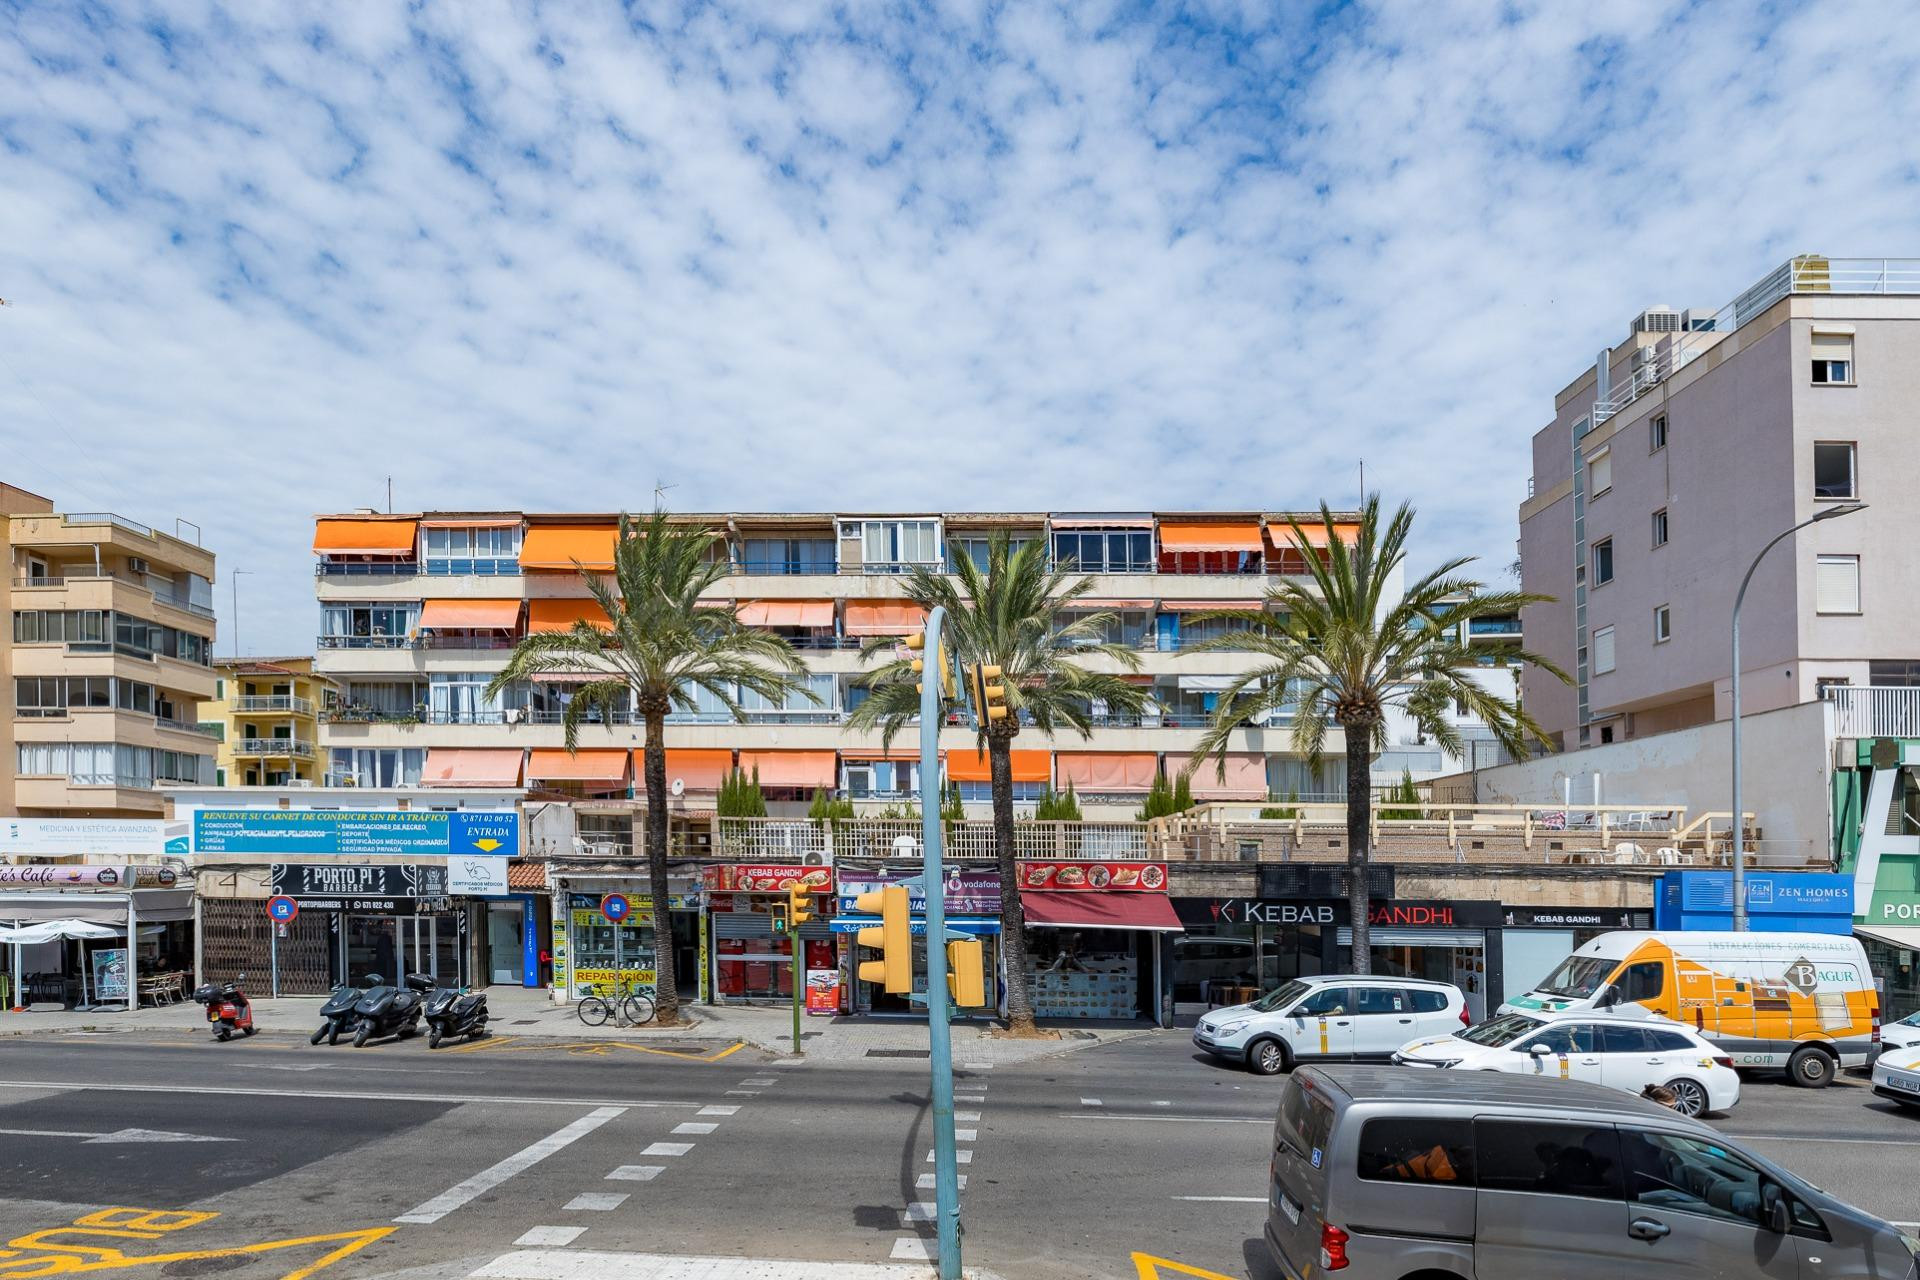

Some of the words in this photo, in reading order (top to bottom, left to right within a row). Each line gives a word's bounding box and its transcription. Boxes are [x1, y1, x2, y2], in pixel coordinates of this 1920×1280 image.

[203, 812, 248, 820] RENUEVE
[249, 812, 260, 820] SU
[263, 812, 301, 820] CARNET
[317, 813, 367, 821] CONDUCIR
[368, 813, 384, 821] SIN
[407, 812, 448, 821] TRÁFICO
[505, 815, 513, 823] 52
[40, 825, 75, 833] MEDICINA
[82, 823, 117, 833] ESTÉTICA
[118, 825, 158, 833] AVANZADA
[467, 827, 509, 836] ENTRADA
[21, 867, 56, 887] Café
[314, 868, 355, 884] PORTO
[360, 868, 372, 885] PI
[747, 868, 773, 876] KEBAB
[774, 868, 803, 877] GANDHI
[323, 884, 364, 893] BARBERS
[963, 880, 1001, 889] vodafone
[1779, 887, 1801, 897] ZEN
[1806, 888, 1848, 897] HOMES
[1245, 902, 1335, 923] KEBAB
[1533, 915, 1564, 923] KEBAB
[1565, 916, 1601, 924] GANDHI
[1708, 942, 1783, 951] INSTALACIONES
[1788, 942, 1852, 952] COMERCIALES
[577, 970, 653, 982] REPARACIÓN
[1795, 965, 1855, 987] BAGUR
